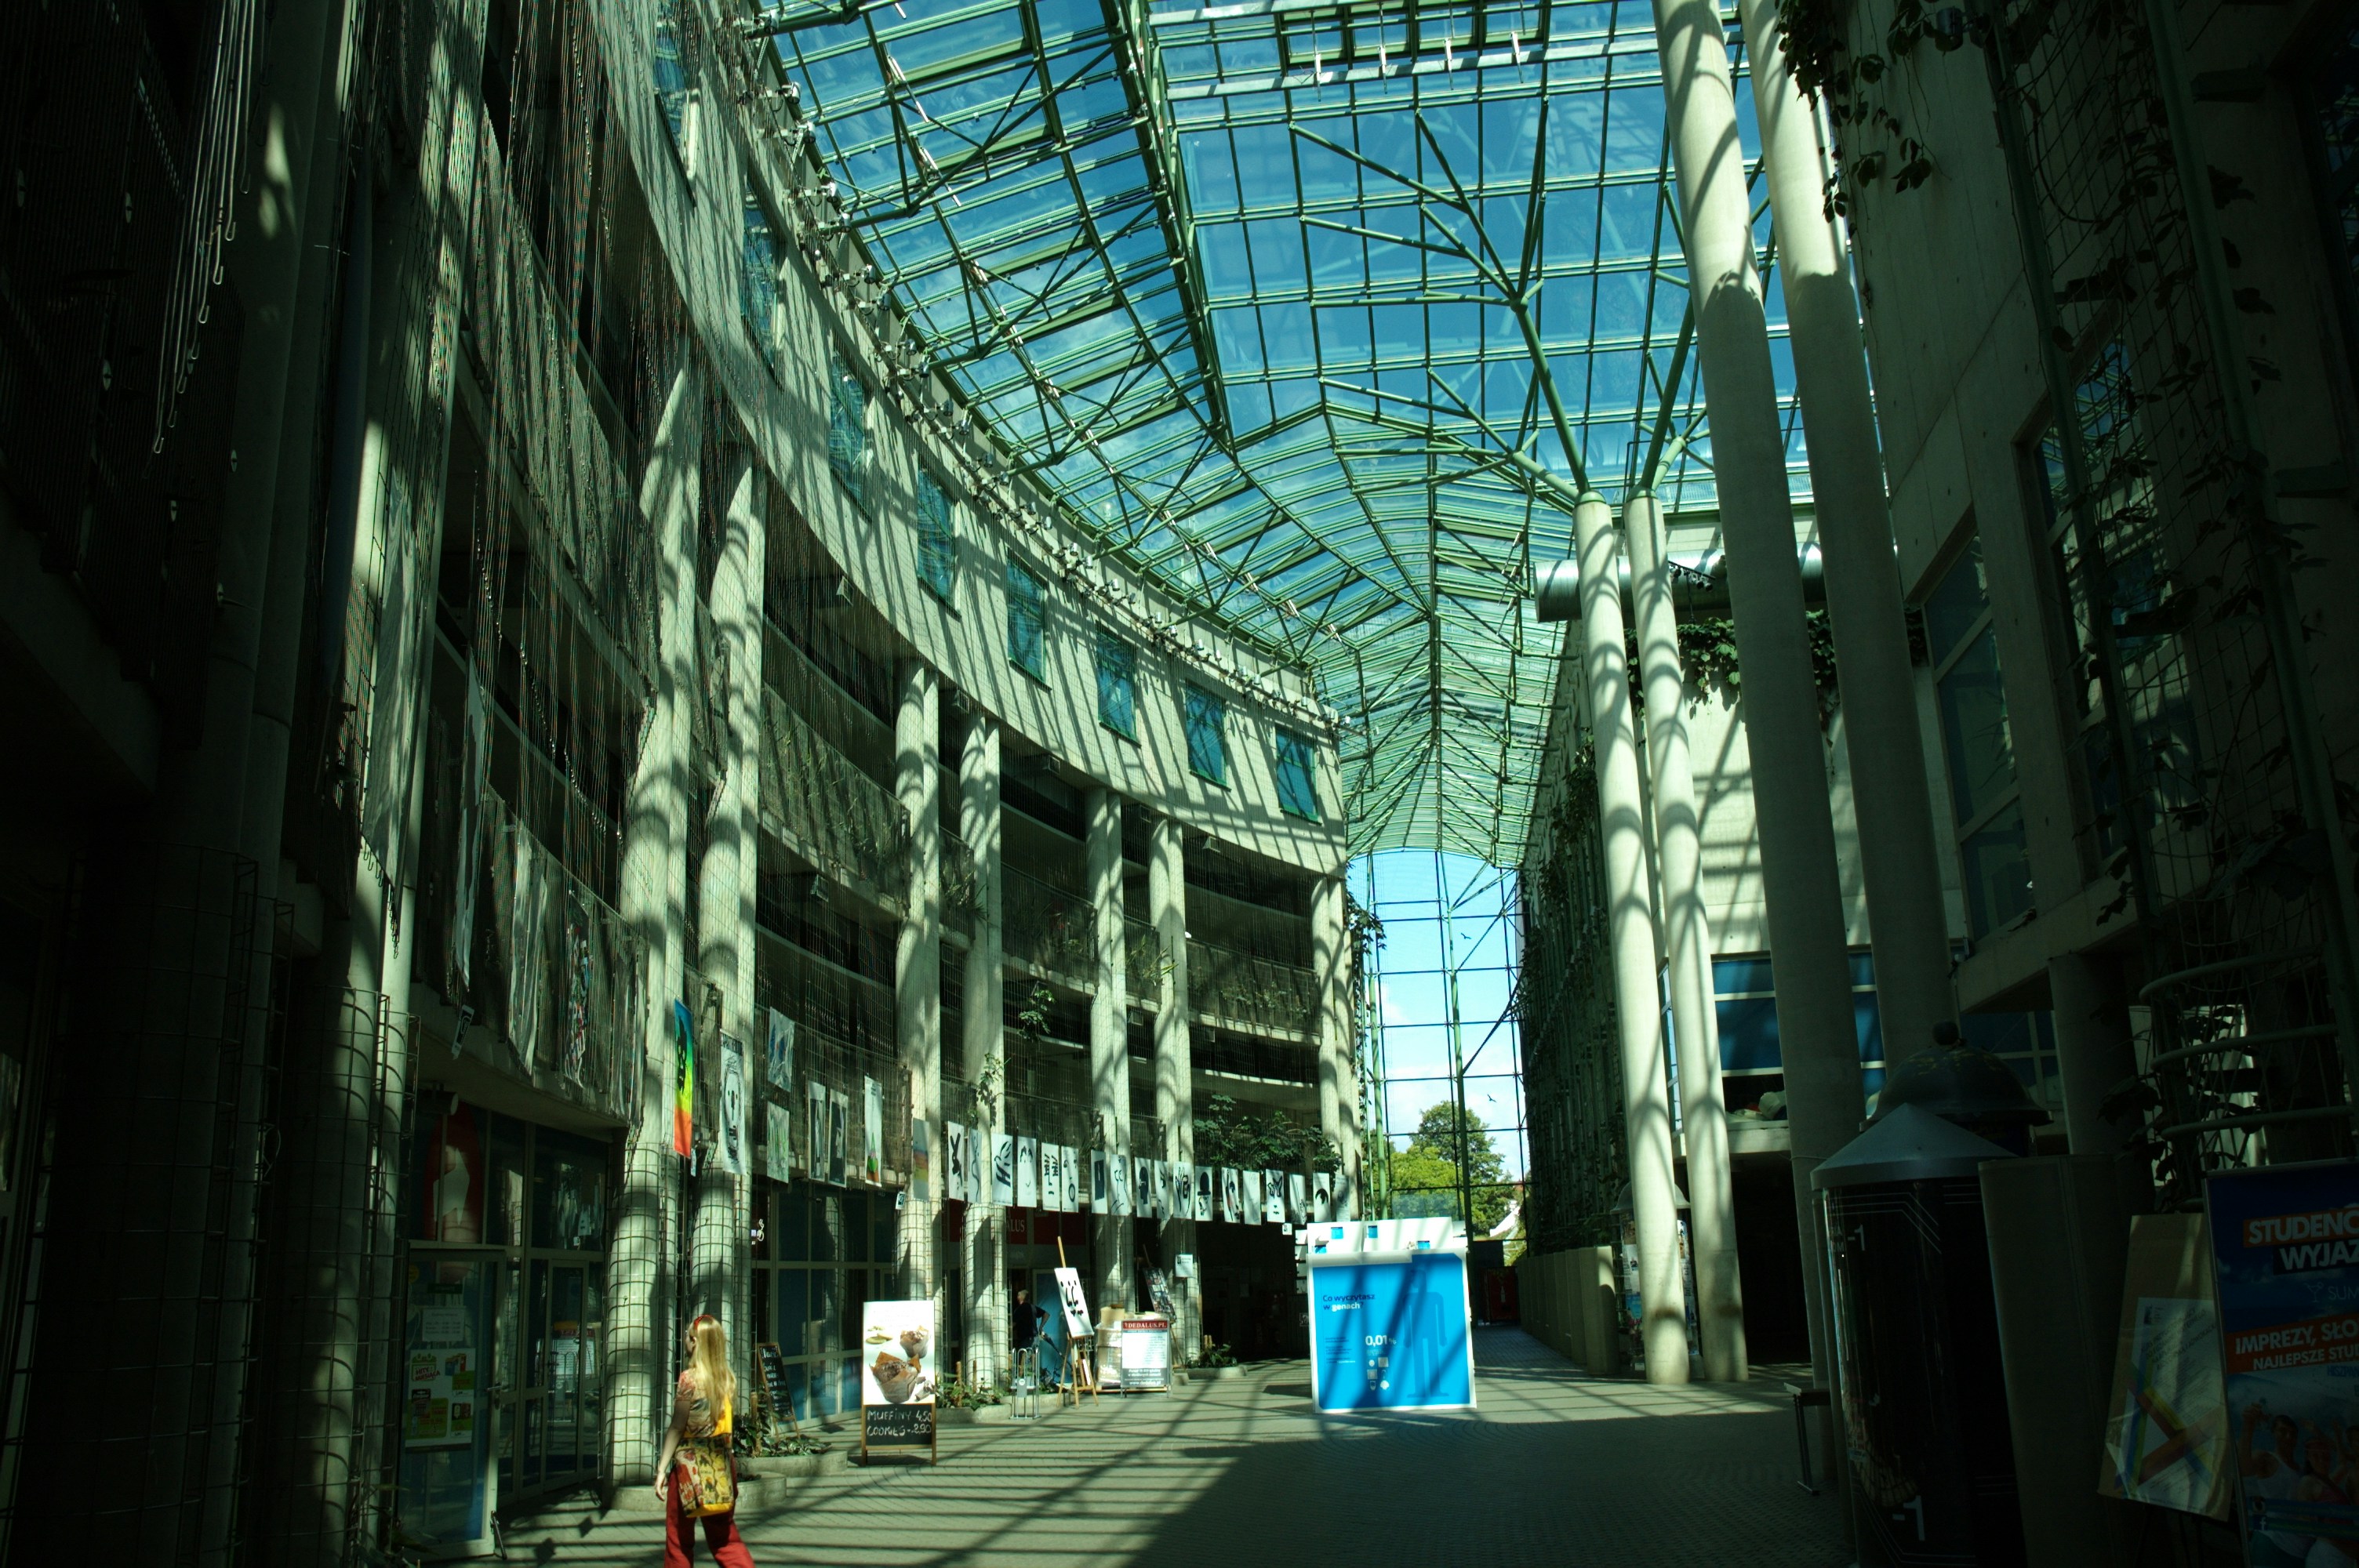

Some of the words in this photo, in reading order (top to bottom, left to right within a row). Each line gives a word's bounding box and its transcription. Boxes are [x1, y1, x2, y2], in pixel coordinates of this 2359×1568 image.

[2235, 1325, 2317, 1355] IMPREZY,
[2321, 1319, 2359, 1341] SŁO
[2253, 1348, 2324, 1370] NAJLEPSZE
